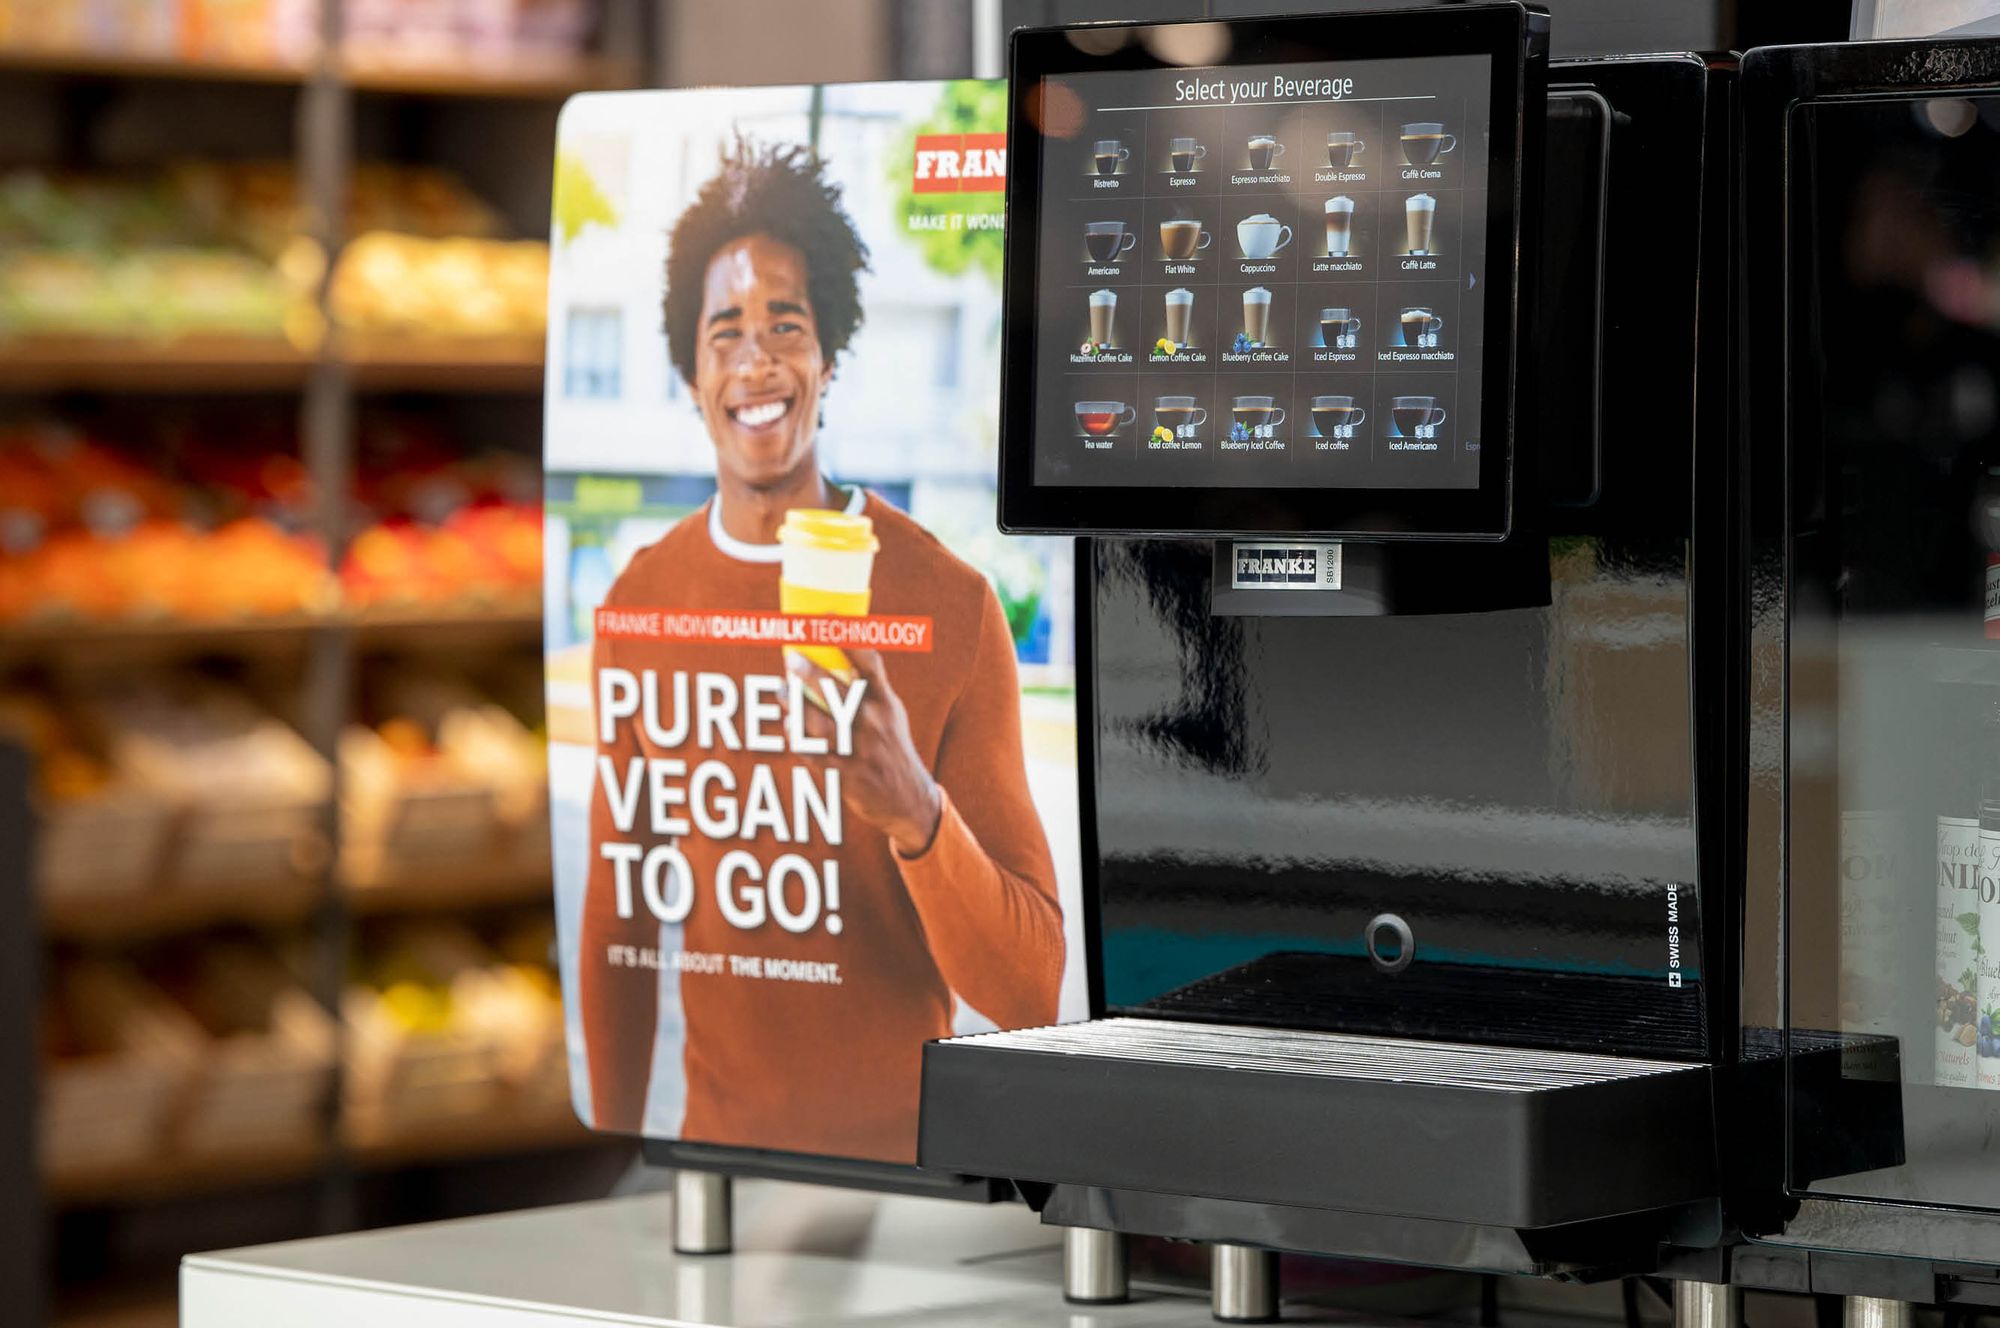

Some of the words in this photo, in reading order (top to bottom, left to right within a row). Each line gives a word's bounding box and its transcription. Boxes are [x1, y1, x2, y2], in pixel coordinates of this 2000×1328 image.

[1175, 78, 1226, 101] Select
[1230, 81, 1268, 104] your
[1273, 76, 1353, 100] Beverage
[915, 148, 1006, 179] FRAN
[1314, 172, 1338, 182] Double
[1338, 172, 1366, 183] Espresso
[1401, 169, 1419, 179] Caffè
[1420, 169, 1442, 179] Crema
[1093, 178, 1120, 189] Ristretto
[1169, 177, 1196, 188] Espresso
[1231, 175, 1258, 186] Espresso
[1258, 174, 1291, 184] macchiato
[909, 214, 946, 230] MAKE
[950, 214, 963, 230] IT
[1164, 264, 1177, 275] Flat
[1177, 264, 1196, 275] White
[1240, 263, 1276, 274] Cappuccino
[1312, 262, 1329, 272] Latte
[1329, 261, 1363, 271] macchiato
[1401, 260, 1419, 270] Caffè
[1419, 260, 1436, 270] Latte
[1088, 266, 1121, 276] Americano
[1070, 353, 1097, 363] Hazelnut
[1097, 353, 1117, 363] Coffee
[1118, 353, 1133, 363] Cake
[1149, 353, 1169, 363] Lemon
[1170, 353, 1190, 362] Coffee
[1191, 353, 1206, 362] Cake
[1222, 352, 1251, 364] Blueberry
[1252, 352, 1273, 362] Coffee
[1273, 352, 1289, 361] Cake
[1314, 352, 1328, 361] Iced
[1328, 352, 1356, 363] Espresso
[1377, 351, 1391, 361] Iced
[1392, 351, 1420, 362] Espresso
[1421, 351, 1454, 360] macchiato
[1084, 440, 1095, 449] Tea
[1095, 440, 1113, 449] water
[1148, 440, 1161, 449] Iced
[1161, 440, 1181, 450] coffee
[1181, 440, 1202, 450] Lemon
[1220, 441, 1249, 452] Blueberry
[1250, 440, 1263, 450] Iced
[1263, 440, 1285, 450] Coffee
[1315, 440, 1328, 450] Iced
[1328, 440, 1349, 450] coffee
[1389, 441, 1403, 450] Iced
[1403, 441, 1438, 451] Americano
[1237, 558, 1316, 574] FRANKE
[1326, 549, 1334, 584] SB1200
[598, 611, 661, 637] FRANKE
[809, 618, 927, 646] TECHNOLOGY
[598, 667, 868, 756] PURELY
[598, 755, 843, 846] VEGAN
[601, 842, 695, 924] TO
[715, 849, 844, 936] GO!
[1667, 883, 1679, 922] MADE
[1668, 926, 1680, 969] SWISS
[607, 945, 637, 967] IT'S
[638, 948, 669, 970] ALL
[670, 950, 725, 974] ABOUT
[728, 955, 762, 978] THE
[764, 958, 843, 985] MOMENT.
